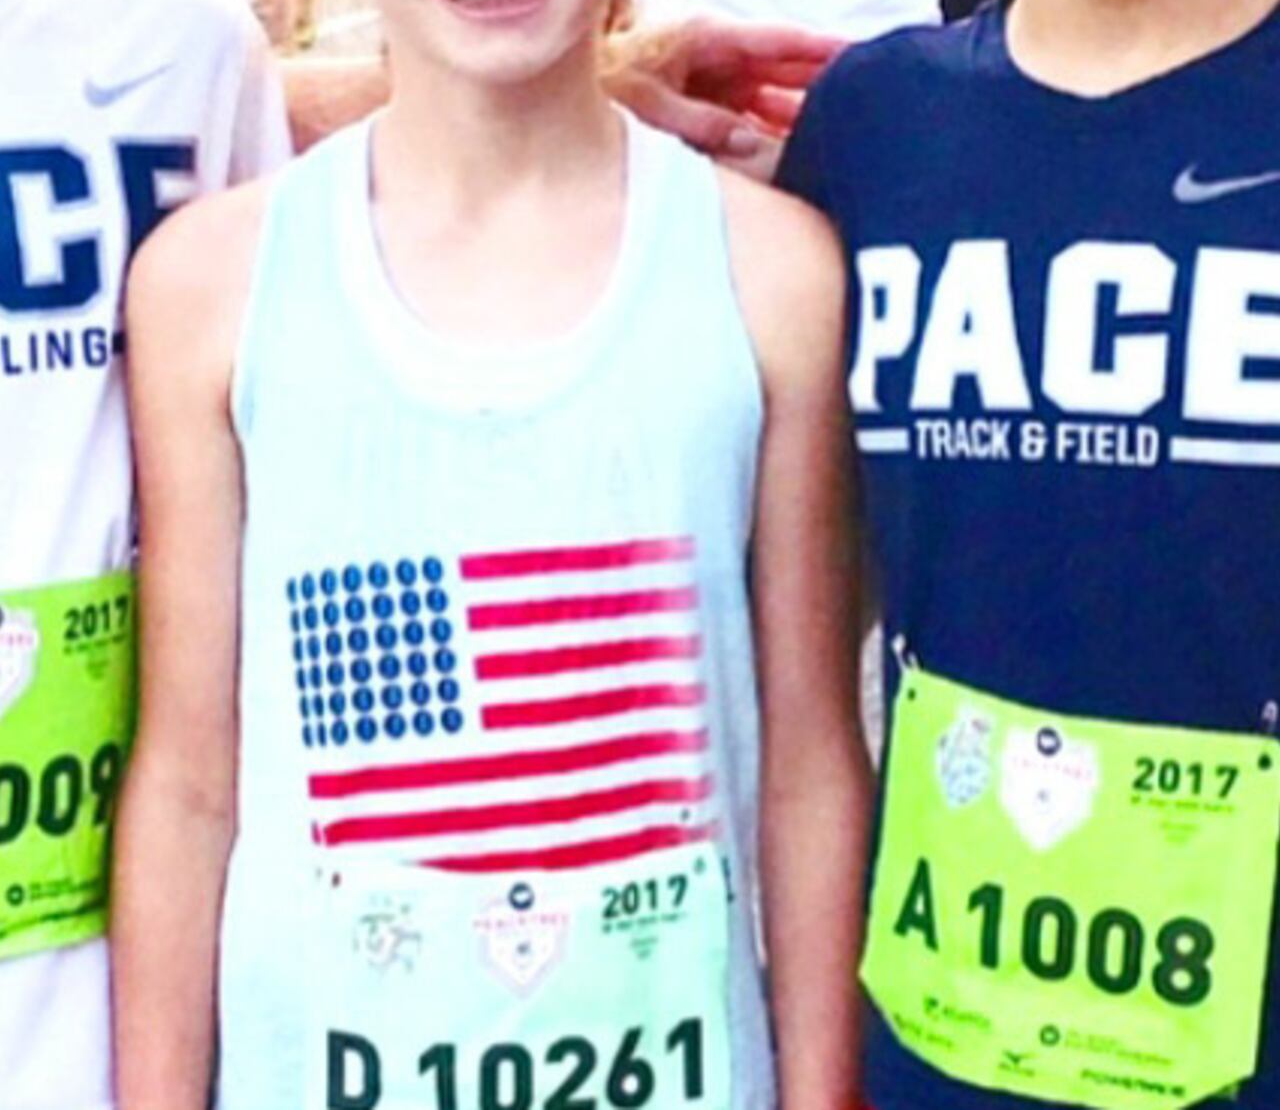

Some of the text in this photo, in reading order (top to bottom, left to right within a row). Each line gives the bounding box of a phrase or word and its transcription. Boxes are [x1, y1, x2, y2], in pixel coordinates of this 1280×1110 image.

[915, 418, 1160, 467] TRACK & FIELD
[62, 595, 130, 641] 2017
[1131, 756, 1239, 800] 2017
[601, 874, 689, 921] 2017
[893, 856, 1215, 1009] A 1008
[326, 1017, 704, 1110] D 10261
